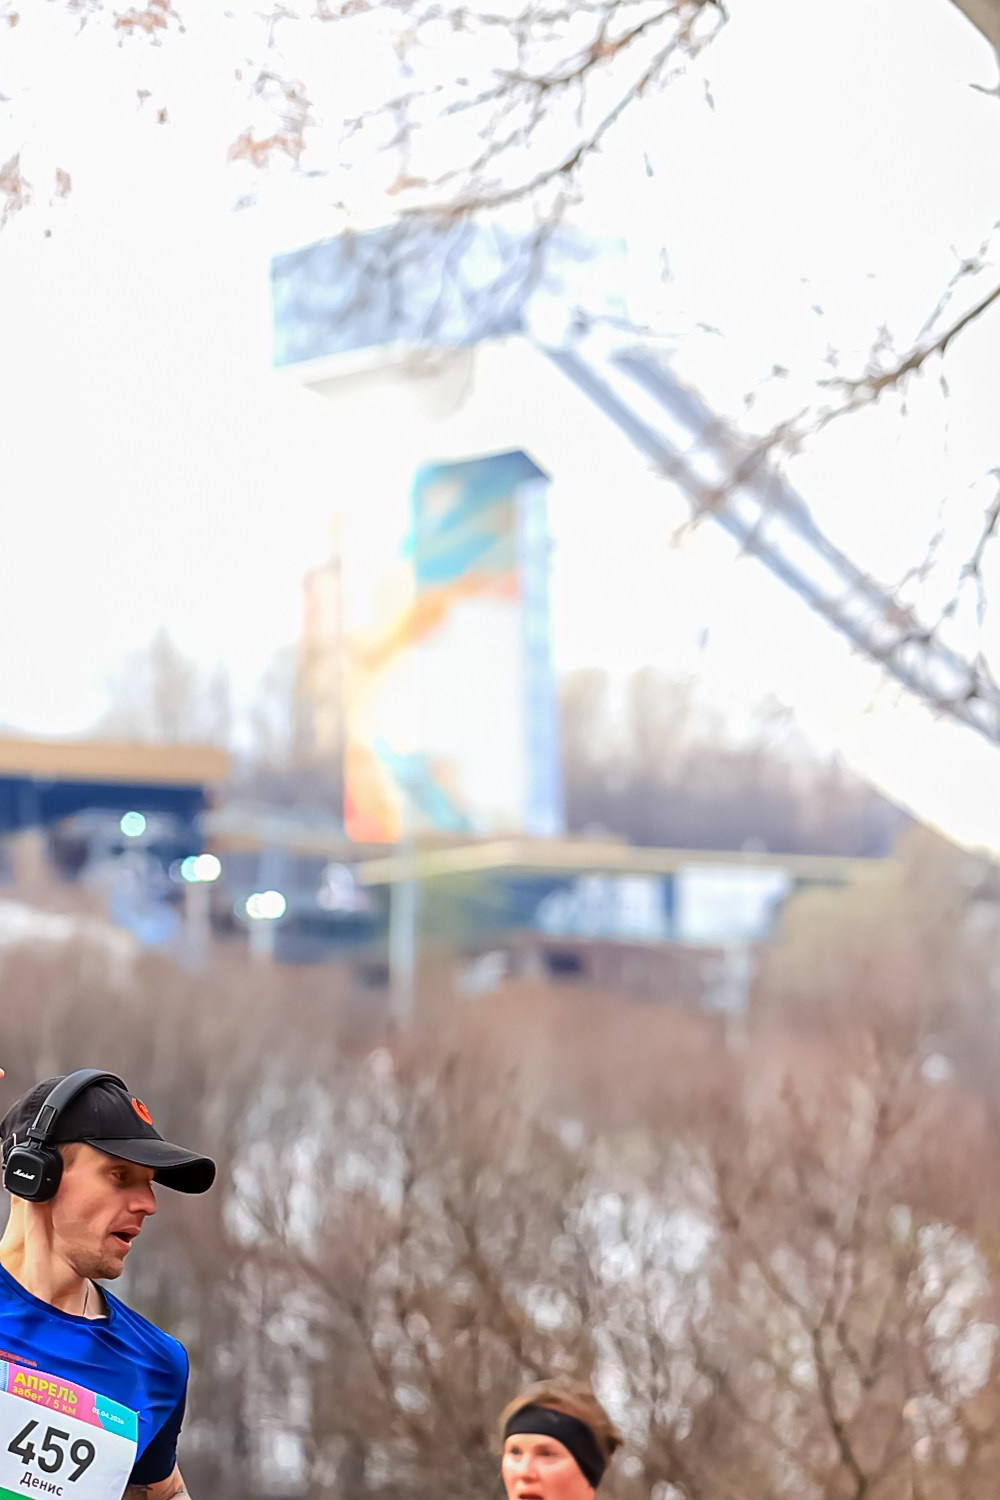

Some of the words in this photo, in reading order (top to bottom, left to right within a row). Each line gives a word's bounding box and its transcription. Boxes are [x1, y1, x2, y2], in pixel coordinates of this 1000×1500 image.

[12, 1386, 43, 1403] забег
[53, 1399, 60, 1409] 5
[62, 1403, 77, 1415] км
[13, 1371, 78, 1404] АПРЕЛЬ
[7, 1419, 97, 1483] 459
[19, 1471, 64, 1497] Денис
